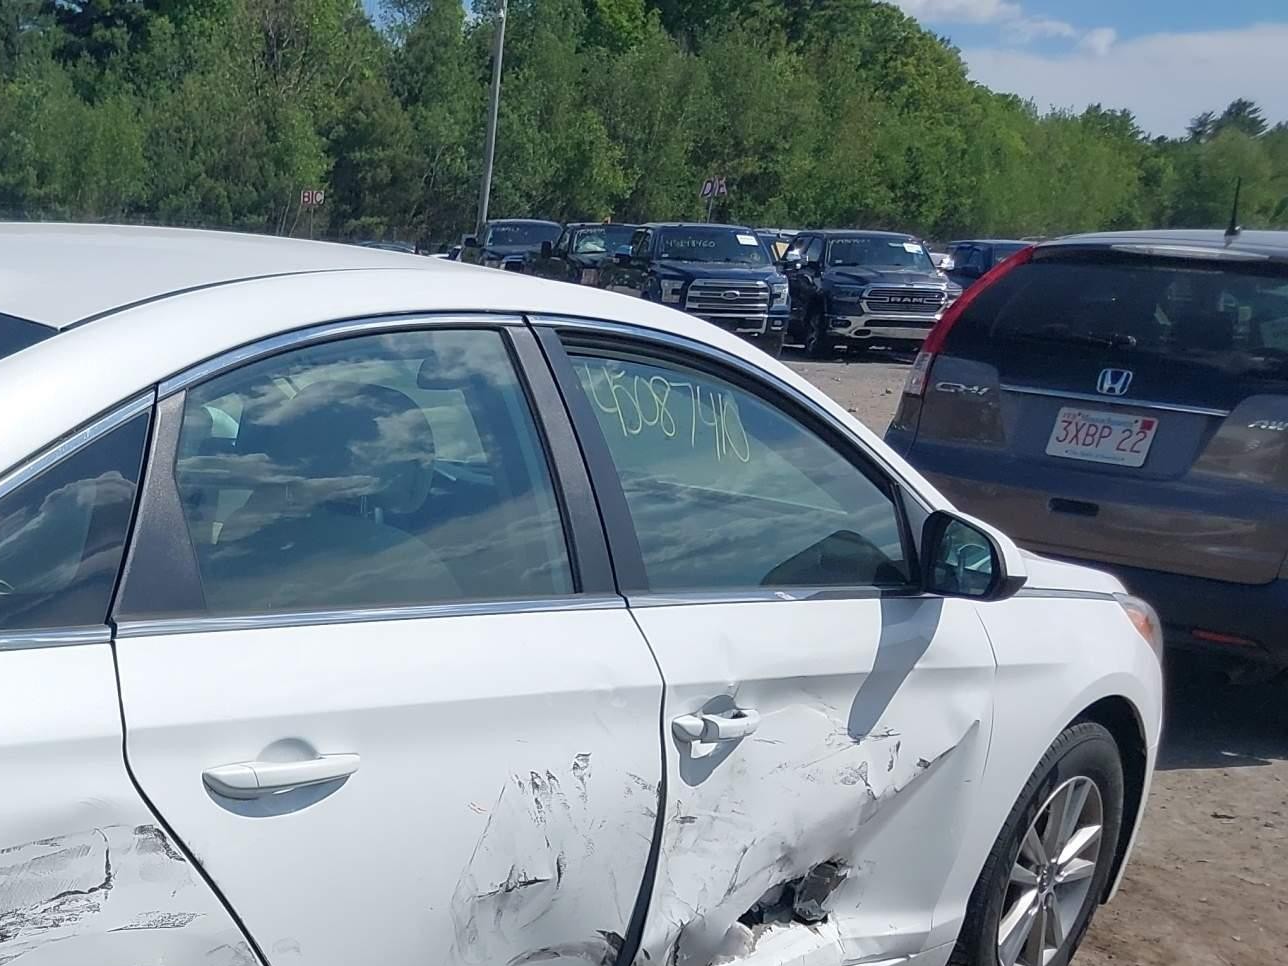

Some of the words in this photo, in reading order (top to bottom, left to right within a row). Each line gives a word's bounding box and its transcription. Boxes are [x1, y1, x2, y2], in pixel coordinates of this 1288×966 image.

[890, 296, 923, 304] RAM
[584, 362, 750, 463] 45087410
[1055, 420, 1113, 449] 3XBP
[1115, 428, 1148, 454] 22
